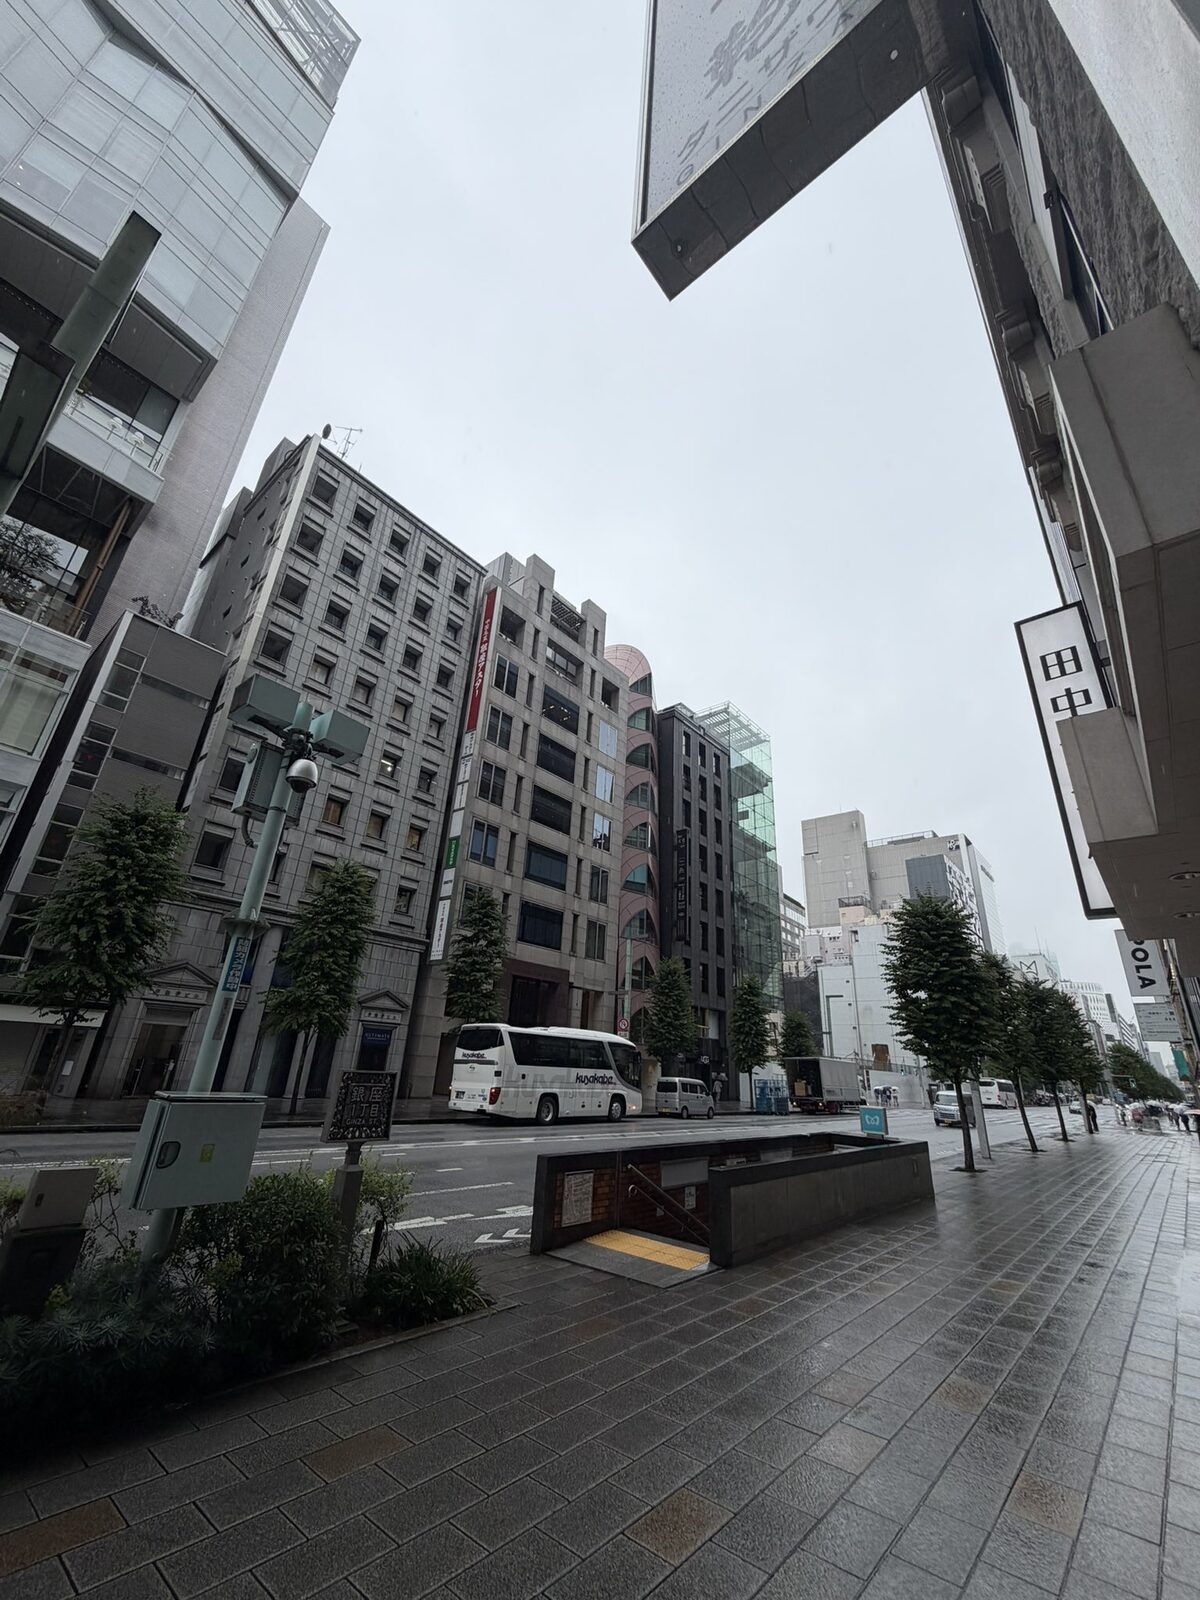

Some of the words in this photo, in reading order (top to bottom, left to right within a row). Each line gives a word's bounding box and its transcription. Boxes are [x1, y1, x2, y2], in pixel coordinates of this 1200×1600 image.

[677, 11, 853, 186] GINZA
[1039, 645, 1093, 717] 田中
[350, 1086, 384, 1103] 銀座
[351, 1103, 380, 1118] 1丁目
[346, 1118, 366, 1126] GINZA
